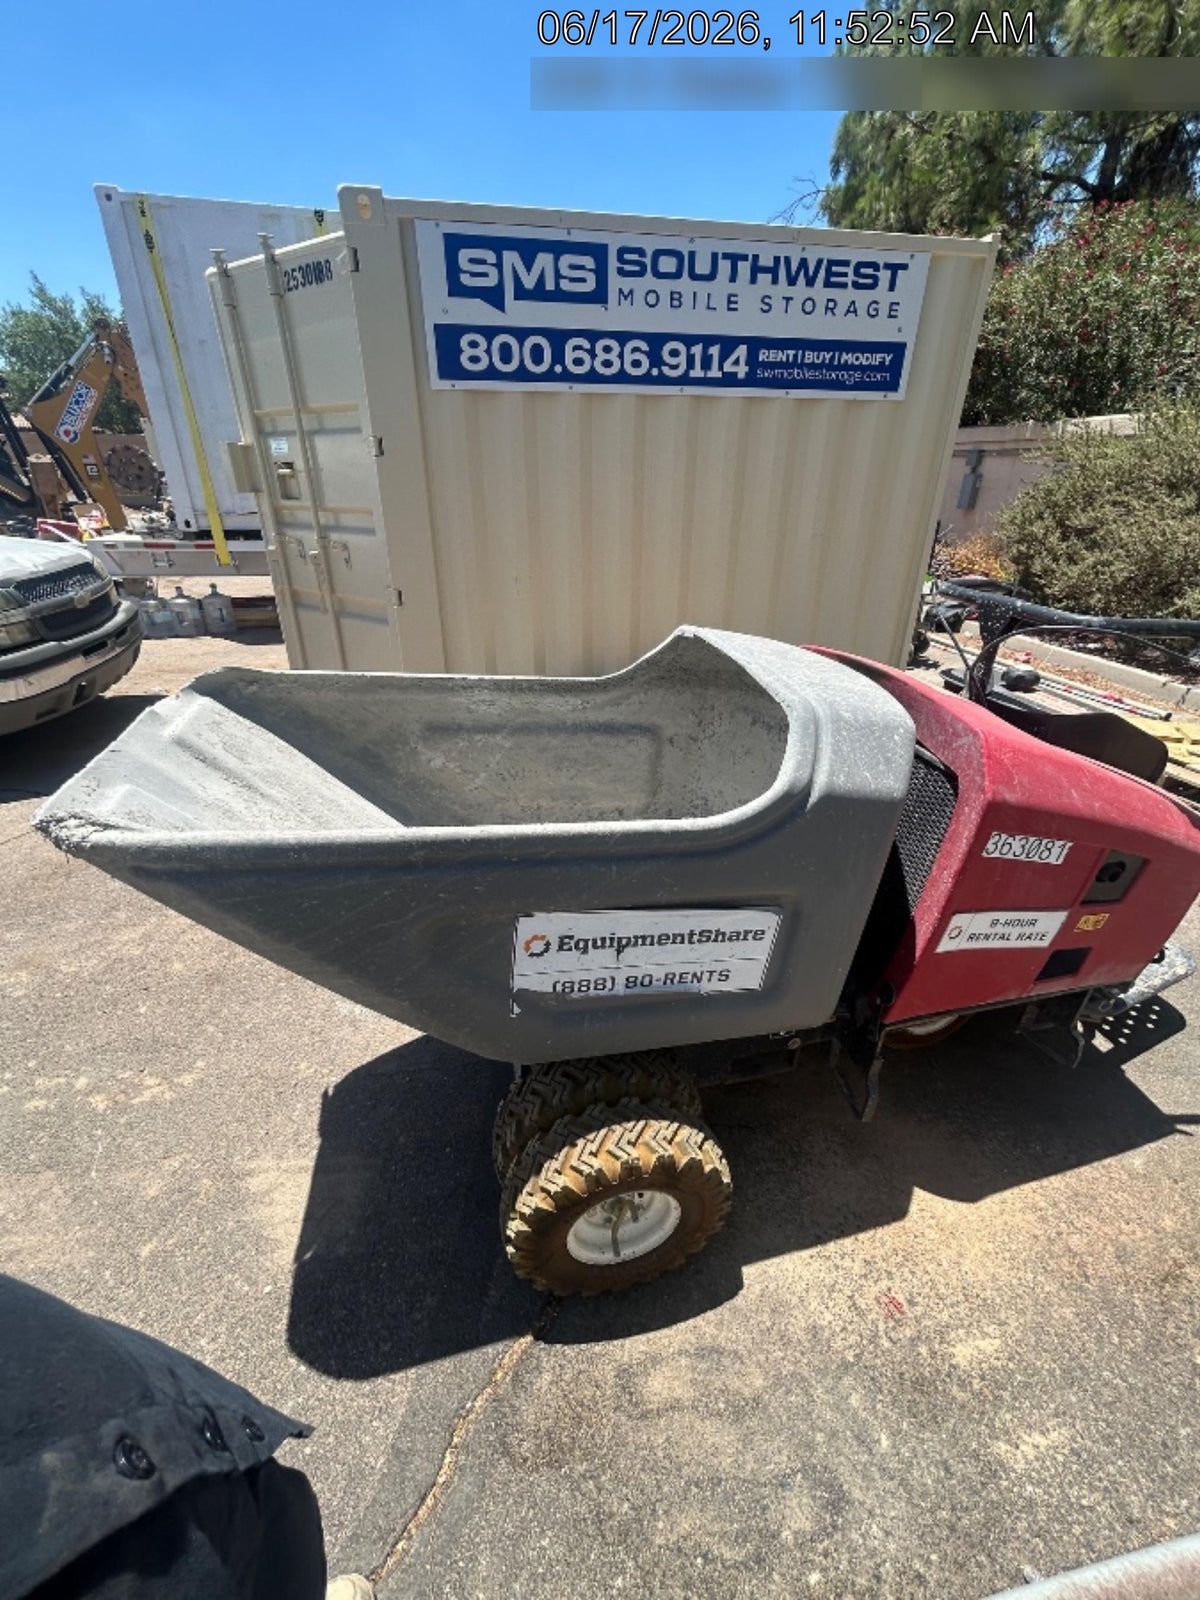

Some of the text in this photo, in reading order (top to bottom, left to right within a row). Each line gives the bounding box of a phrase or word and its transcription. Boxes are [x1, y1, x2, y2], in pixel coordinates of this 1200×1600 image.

[457, 246, 598, 293] SMS
[615, 245, 909, 293] SOUTHWEST
[616, 287, 901, 320] MOBILE STORAGE
[459, 332, 750, 380] 800.686.9114
[756, 366, 890, 384] swmobilestorage.com
[984, 833, 1067, 862] 363081
[966, 931, 1049, 942] RENTAL RATE
[989, 918, 1038, 928] 8-HOUR
[556, 927, 767, 956] EquipmentShare
[552, 968, 732, 996] (888) 80-RENTS
